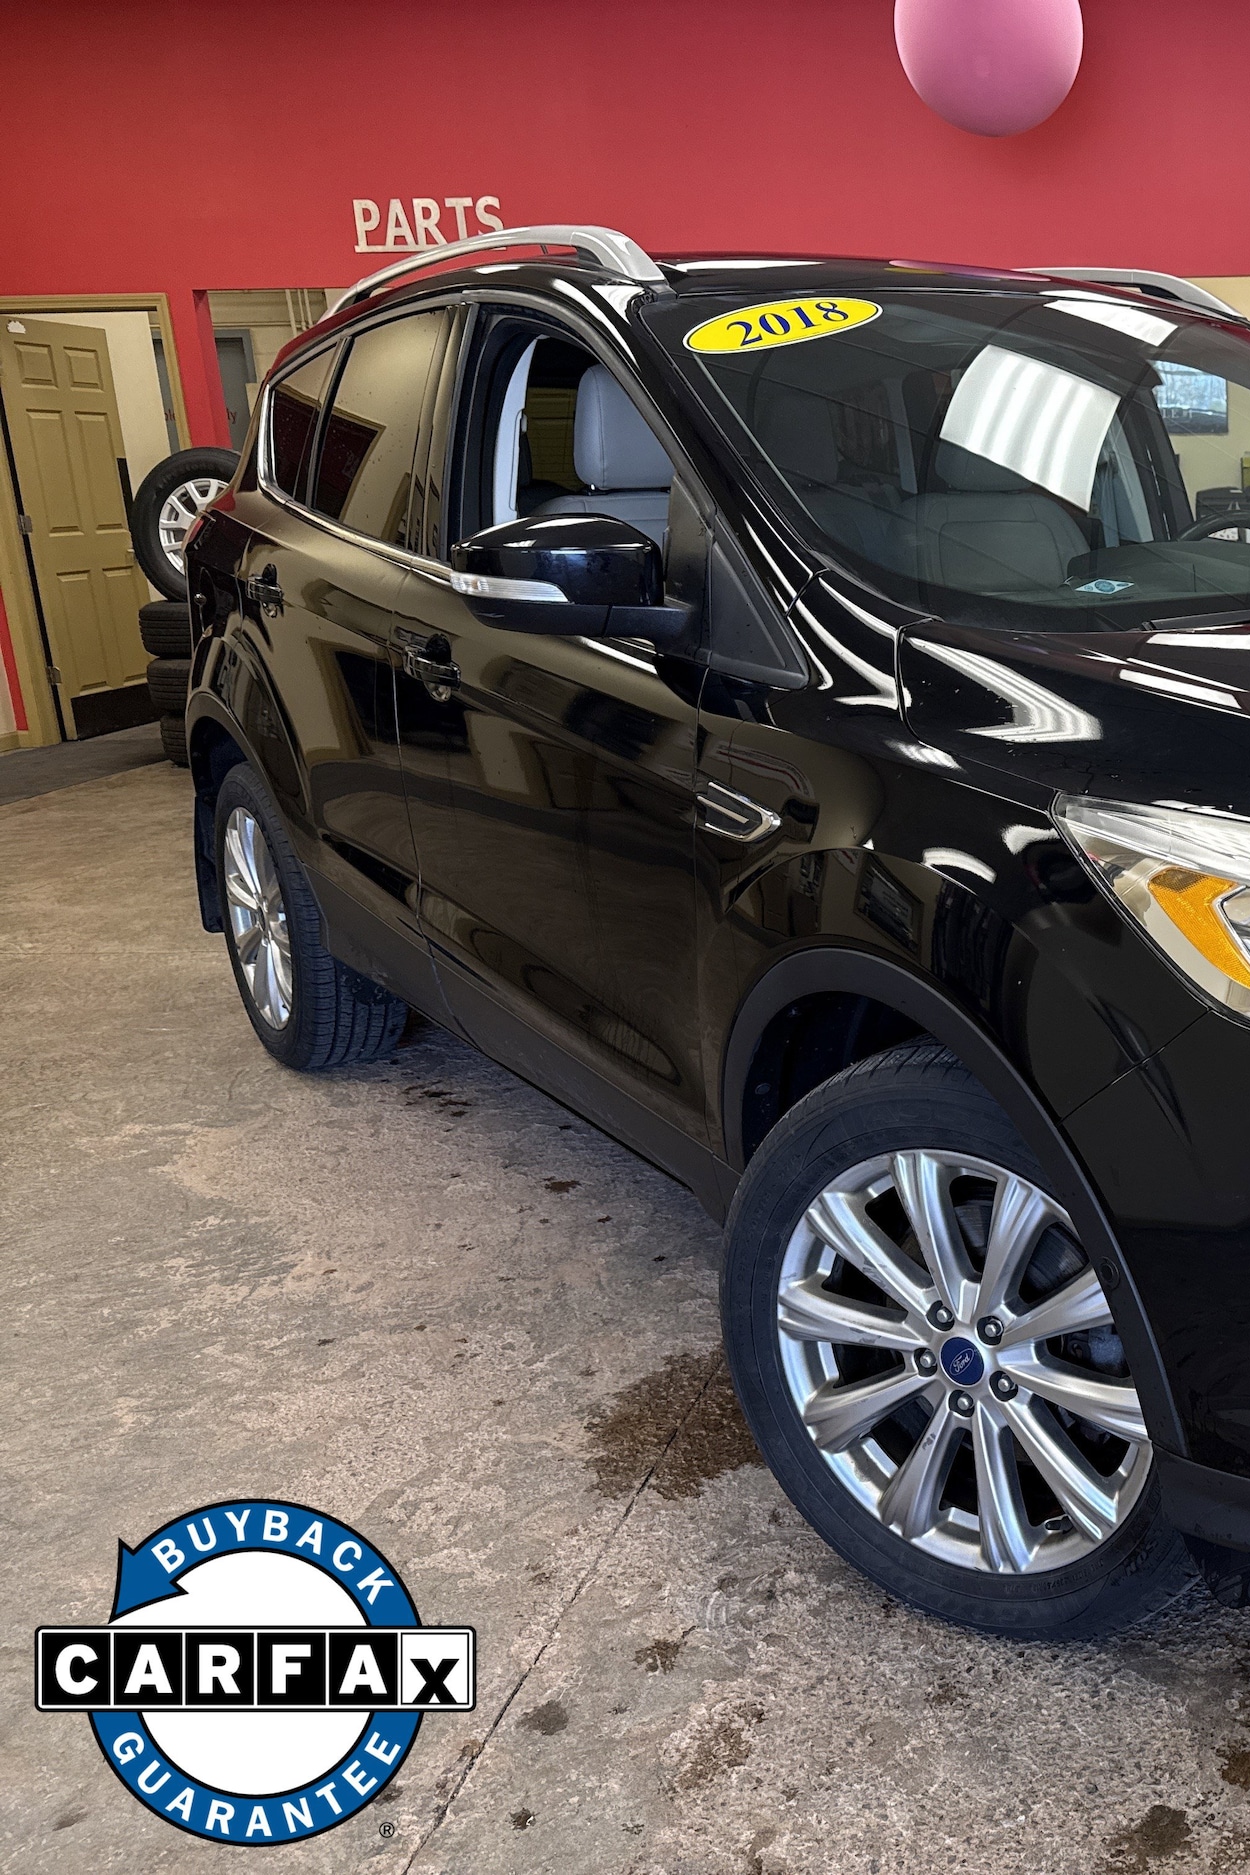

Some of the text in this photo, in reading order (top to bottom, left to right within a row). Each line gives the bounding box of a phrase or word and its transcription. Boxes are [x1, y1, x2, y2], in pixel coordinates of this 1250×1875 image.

[353, 196, 505, 249] PARTS
[726, 301, 849, 347] 2018
[952, 1352, 971, 1374] Ford
